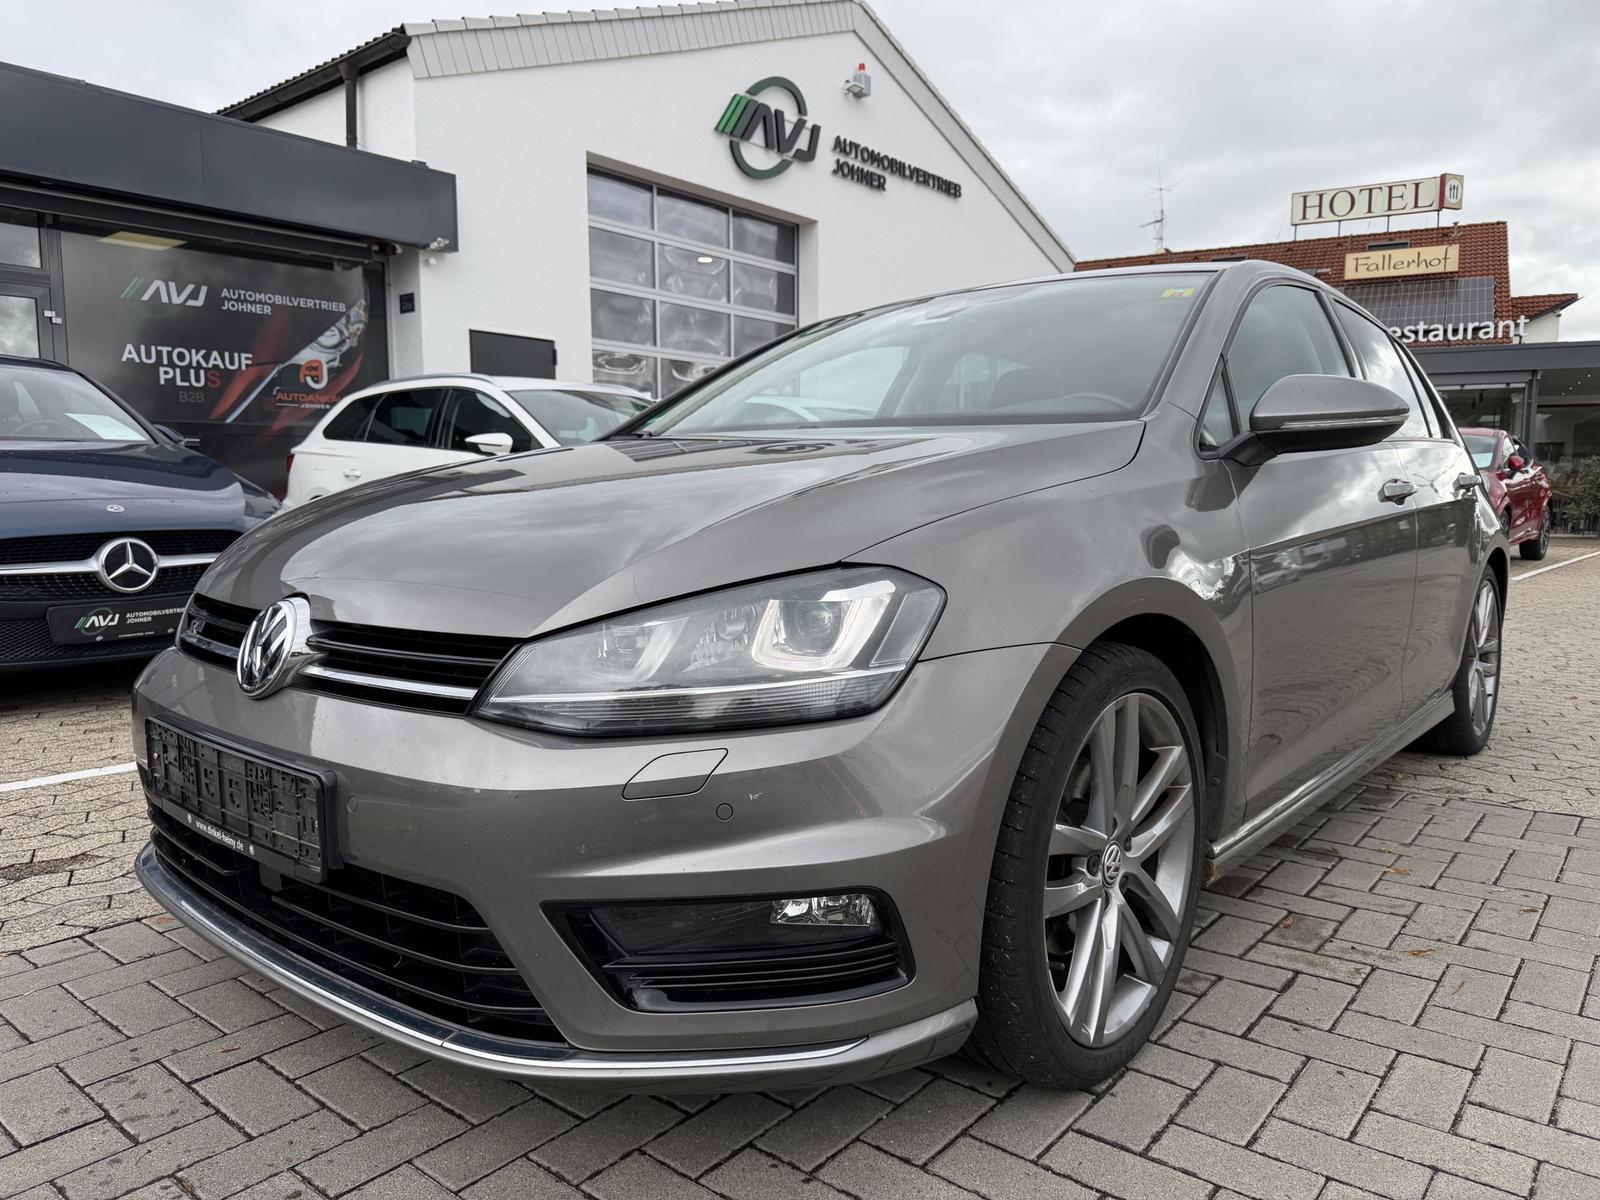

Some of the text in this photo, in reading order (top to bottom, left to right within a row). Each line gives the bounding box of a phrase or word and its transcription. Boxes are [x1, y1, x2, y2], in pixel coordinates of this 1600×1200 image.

[832, 158, 886, 192] JOHNER
[833, 135, 962, 199] AUTOMOBILVERTRIEB
[1299, 180, 1436, 221] HOTEL
[1352, 245, 1452, 273] Fallerhof
[220, 288, 347, 313] AUTOMOBILVERTRIEB
[221, 300, 273, 316] JOHNER
[1388, 315, 1530, 343] estaurant
[121, 343, 254, 371] AUTOKAUF
[158, 366, 221, 389] PLUS
[179, 391, 205, 403] B2B
[126, 616, 153, 624] JOHNER
